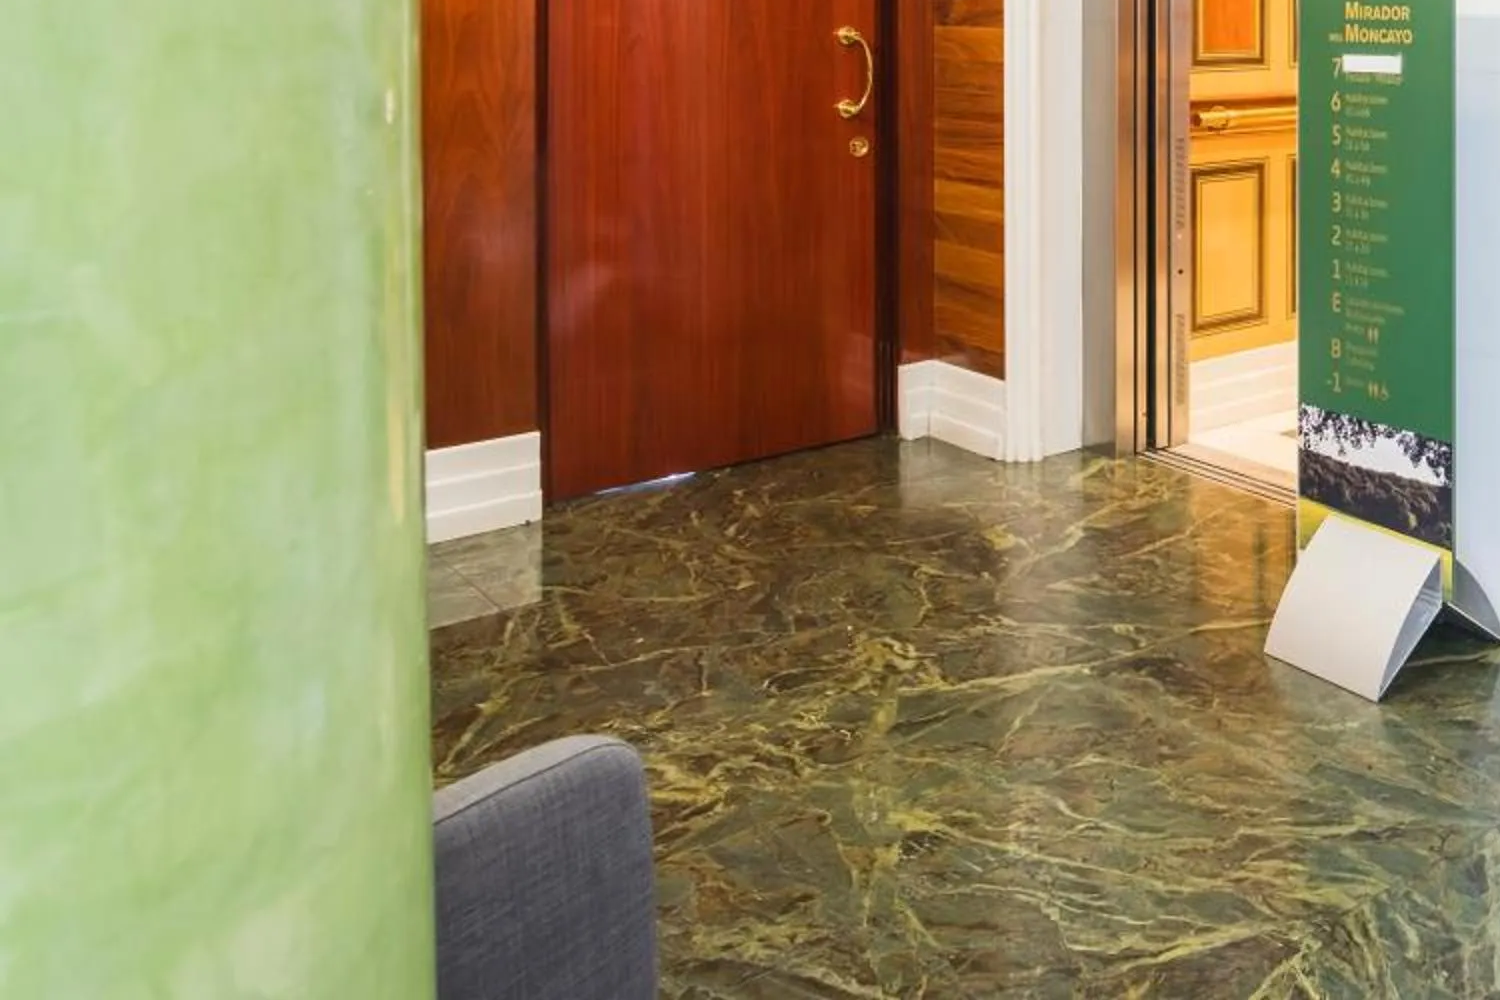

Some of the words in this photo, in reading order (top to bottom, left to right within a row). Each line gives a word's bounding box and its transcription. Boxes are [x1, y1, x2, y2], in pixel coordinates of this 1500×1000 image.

[1331, 91, 1341, 112] 6
[1332, 124, 1342, 146] 5
[1331, 158, 1341, 179] 4
[1332, 191, 1342, 213] 3
[1331, 224, 1342, 246] 2
[1332, 258, 1342, 280] 1
